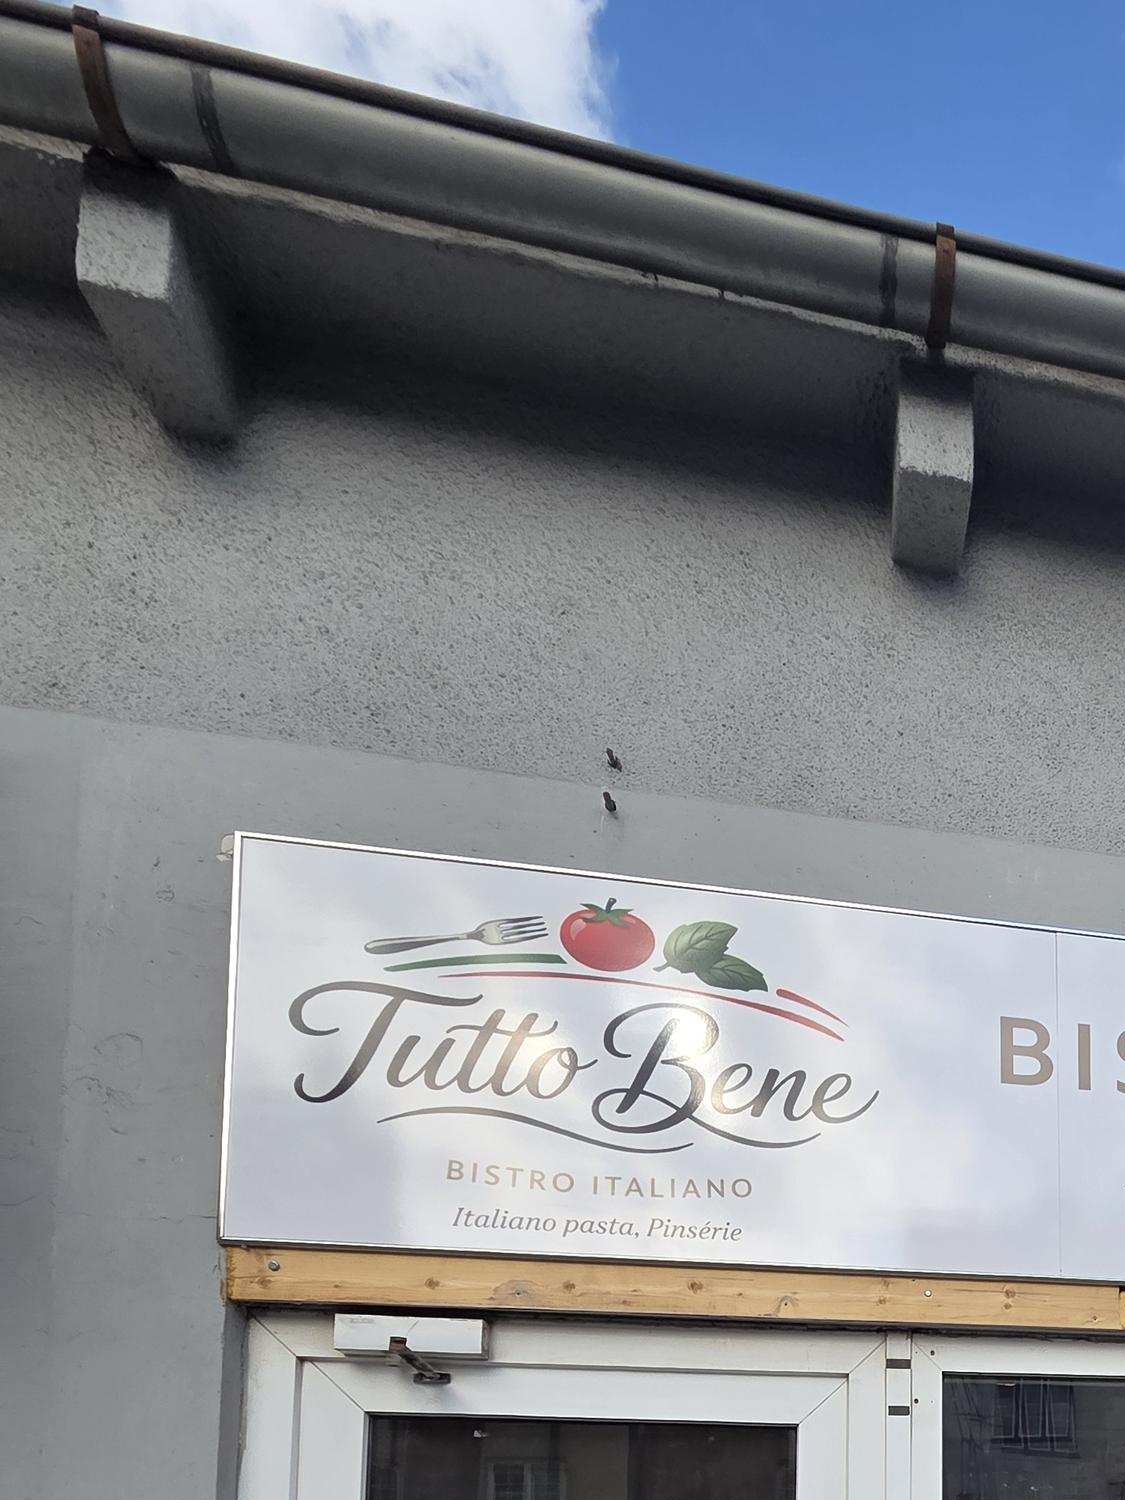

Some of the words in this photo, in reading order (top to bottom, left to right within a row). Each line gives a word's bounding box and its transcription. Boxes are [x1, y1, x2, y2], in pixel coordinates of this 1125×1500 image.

[288, 980, 597, 1102] Tutto
[592, 1002, 879, 1146] Bene
[446, 1159, 575, 1193] BISTRO
[592, 1175, 753, 1199] ITALIANO
[452, 1207, 557, 1232] Italiano
[562, 1217, 641, 1239] pasta,
[647, 1217, 743, 1242] Pinsérie
